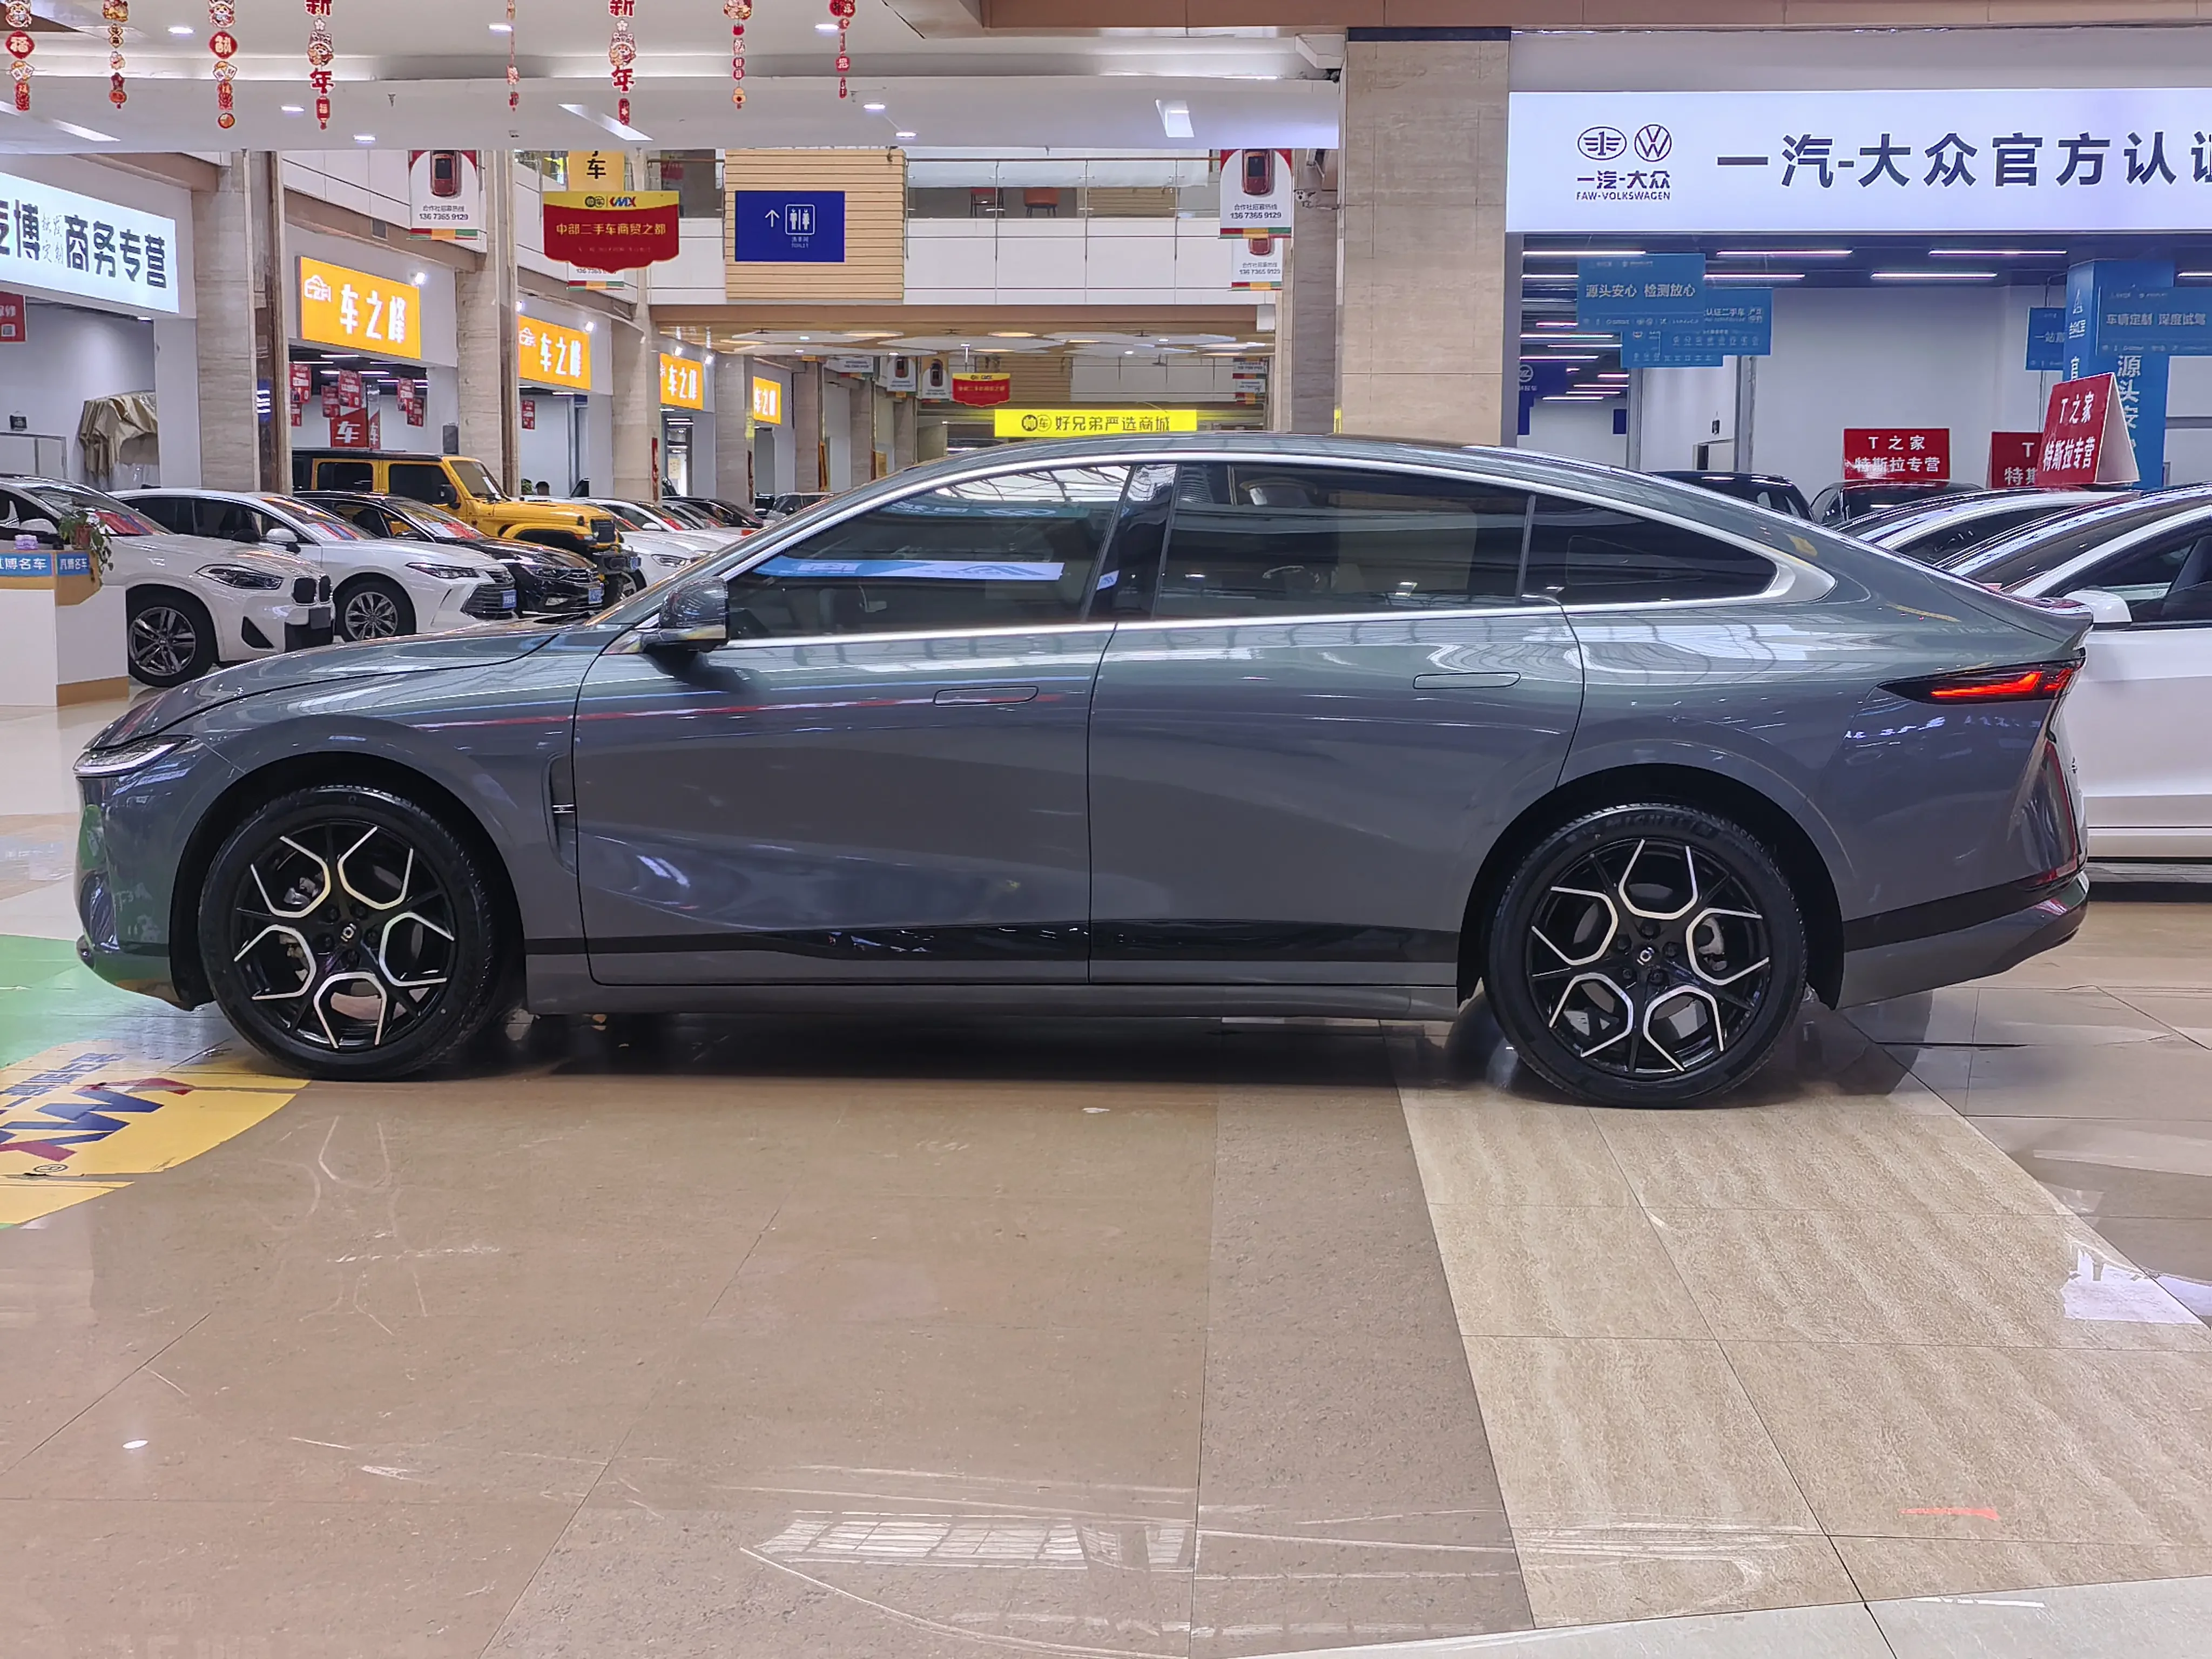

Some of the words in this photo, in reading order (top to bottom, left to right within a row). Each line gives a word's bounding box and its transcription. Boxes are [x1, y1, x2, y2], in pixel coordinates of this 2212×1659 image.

[586, 151, 606, 179] 车
[1577, 170, 1670, 189] 一汽-大众
[1576, 192, 1670, 200] FAW-VOLKSWAGEN
[556, 223, 666, 235] 中部二手车商贸之都
[64, 214, 167, 288] 商务专营
[1586, 284, 1637, 298] 源头安心
[1644, 283, 1695, 298] 检测放心
[2117, 355, 2142, 448] 源头安
[1055, 416, 1171, 432] 好兄弟严选商城
[2042, 436, 2095, 472] 特斯拉专营
[1854, 456, 1940, 473] 特斯拉专营
[0, 558, 48, 570] 博名车
